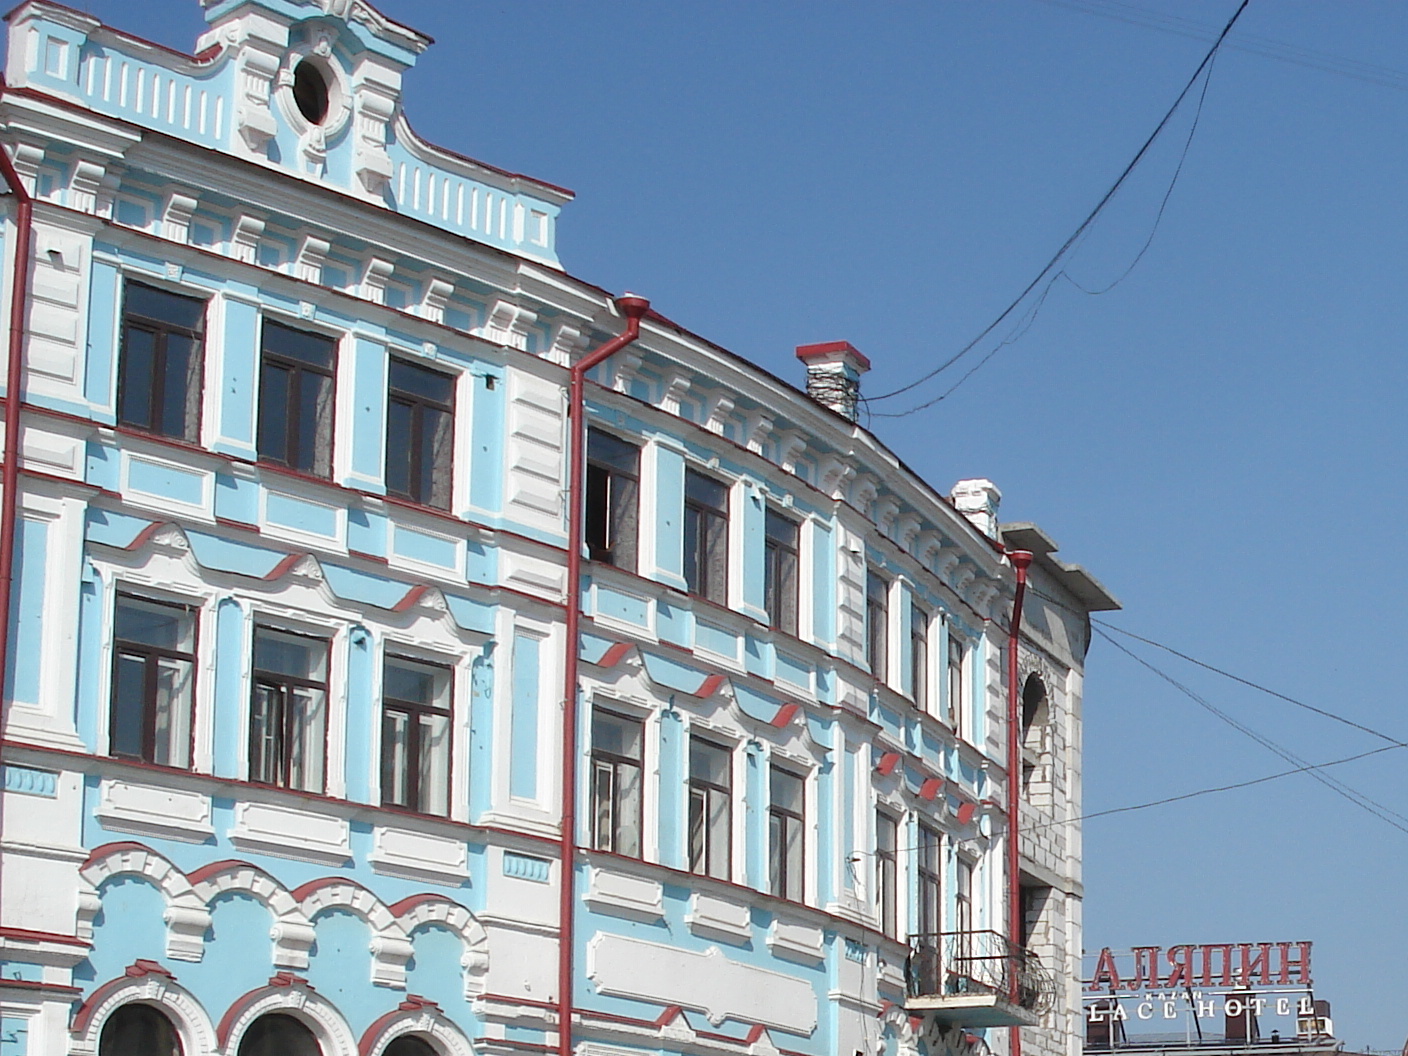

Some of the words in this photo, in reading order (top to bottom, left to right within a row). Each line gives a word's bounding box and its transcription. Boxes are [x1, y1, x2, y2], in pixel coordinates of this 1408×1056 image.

[1088, 941, 1314, 991] АЛЯПИН
[1145, 991, 1204, 1001] KAZAN
[1088, 1001, 1178, 1023] LACE
[1197, 997, 1315, 1018] HOTEL
